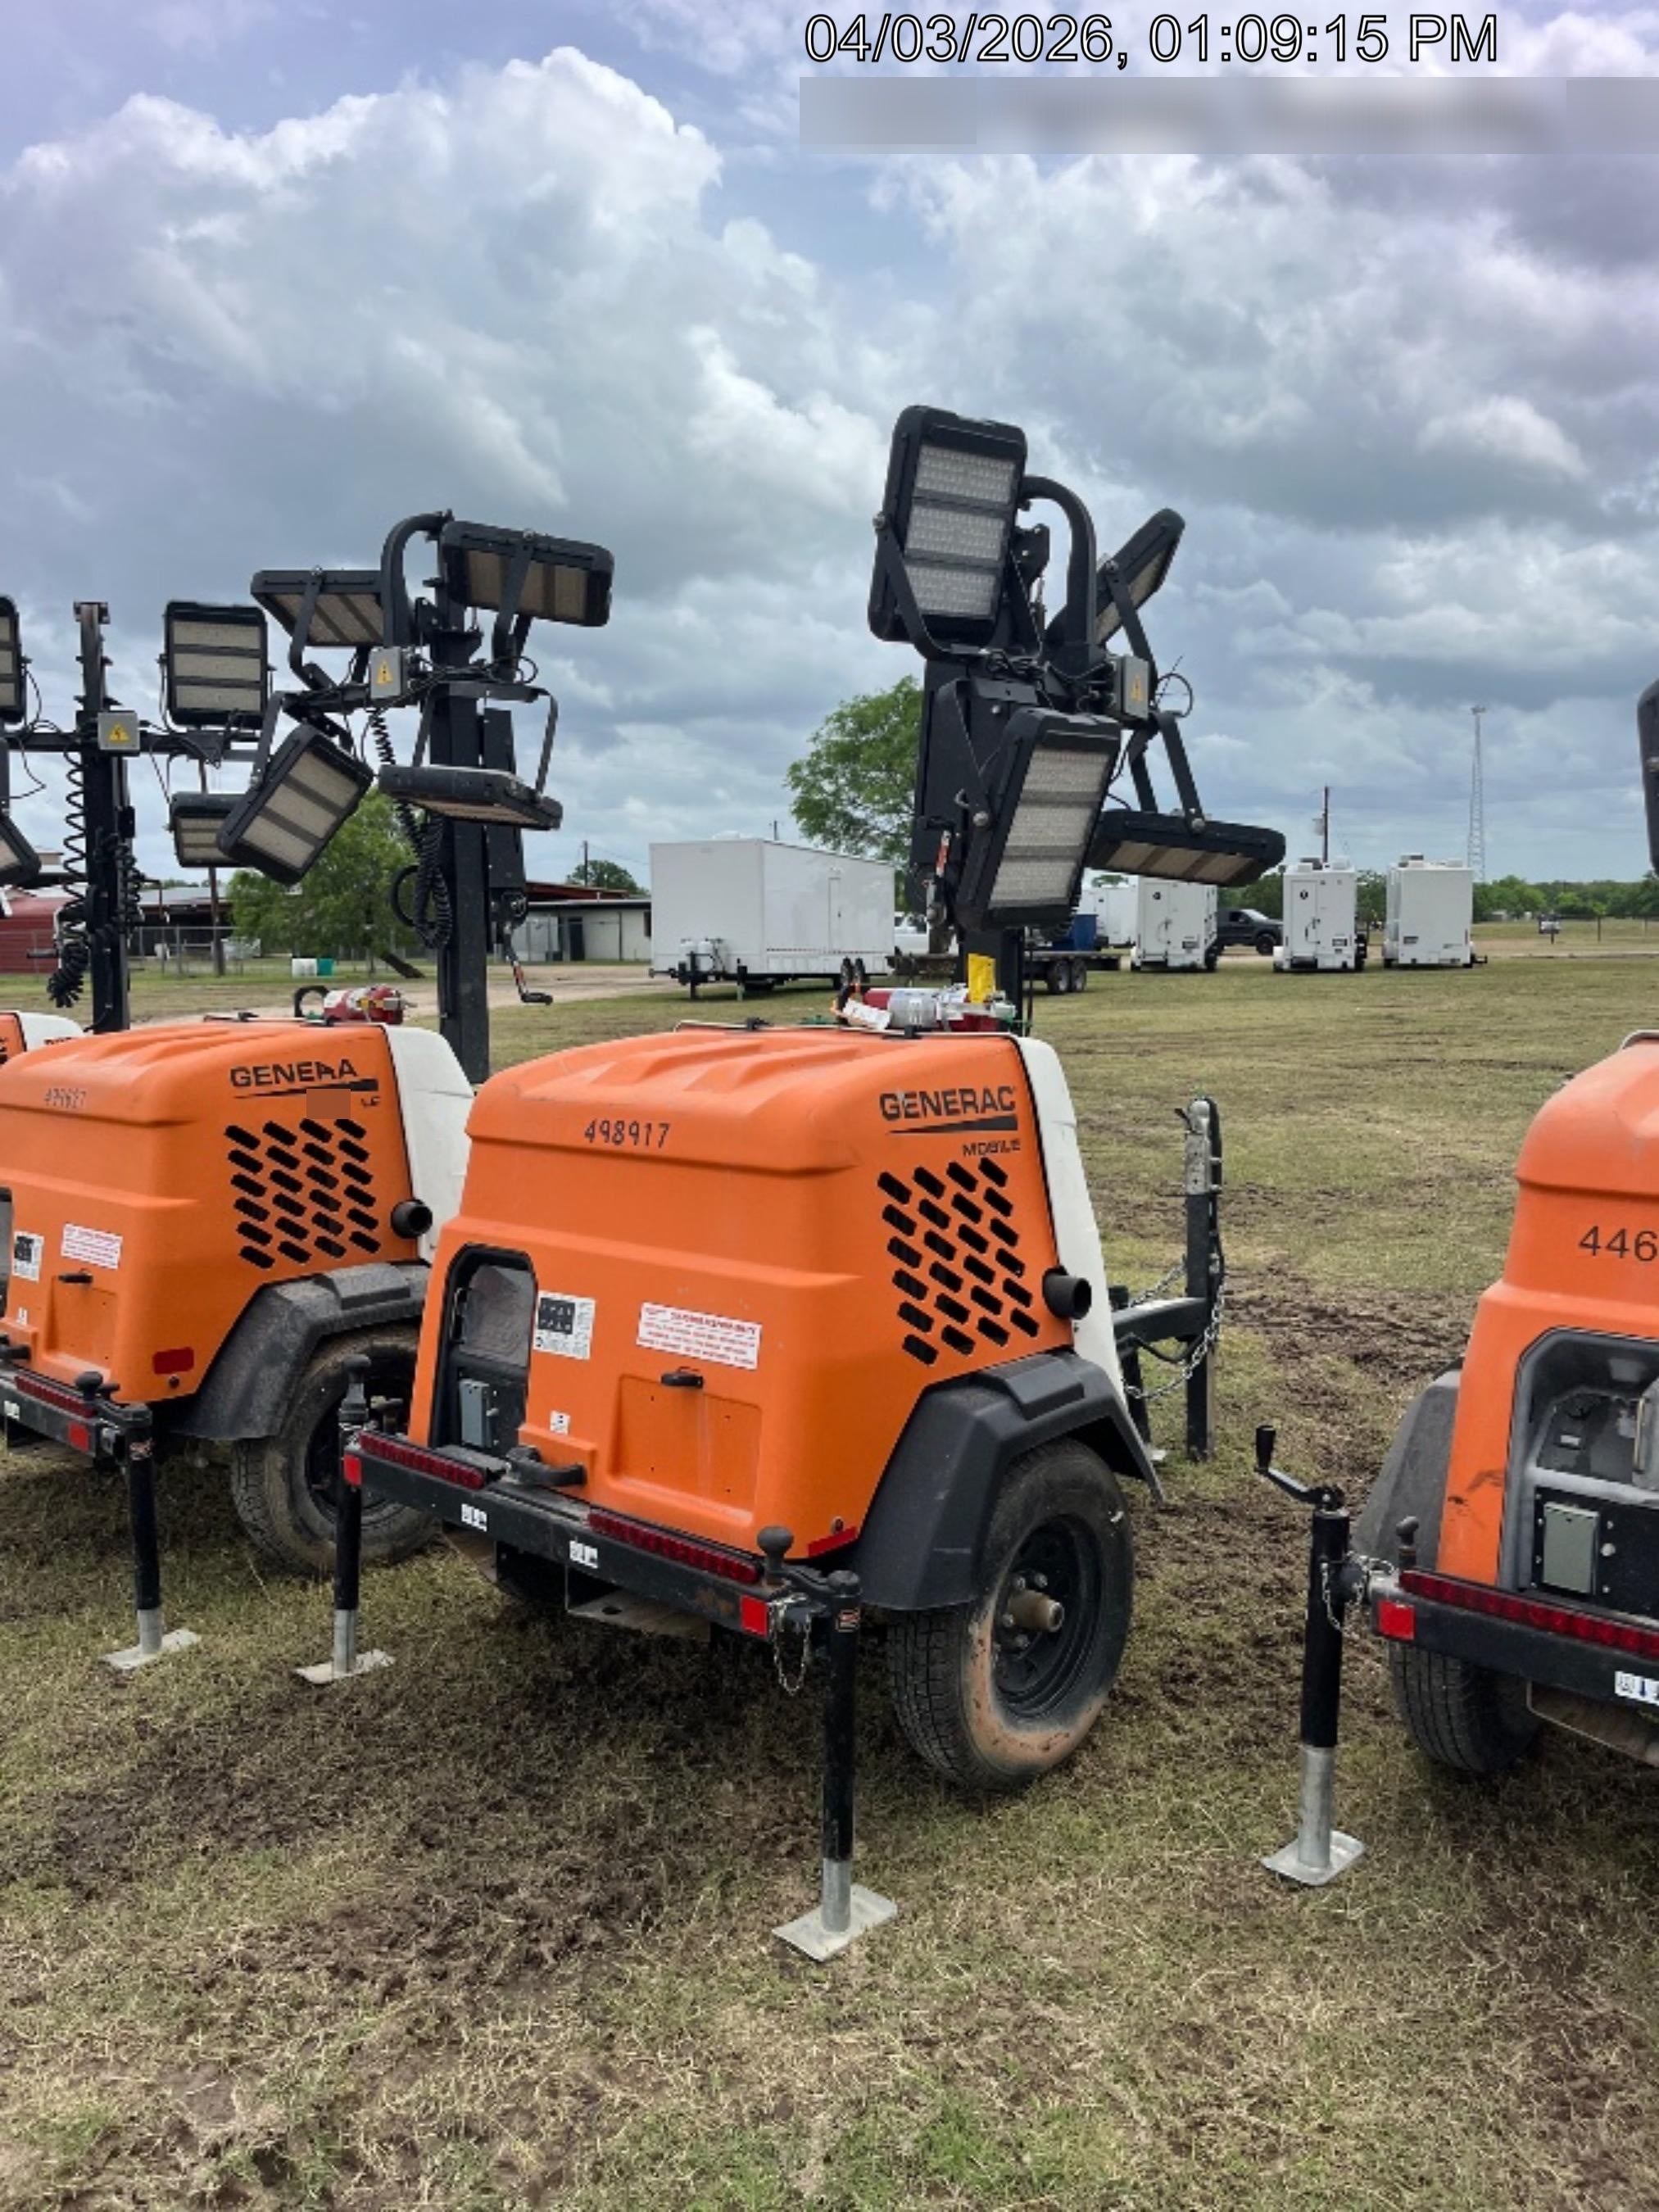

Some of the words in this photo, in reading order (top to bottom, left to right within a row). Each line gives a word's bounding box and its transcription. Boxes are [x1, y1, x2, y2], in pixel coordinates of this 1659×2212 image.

[879, 1086, 1015, 1122] GENERAC
[584, 1118, 671, 1149] 498917
[962, 1138, 1021, 1157] MOBILE
